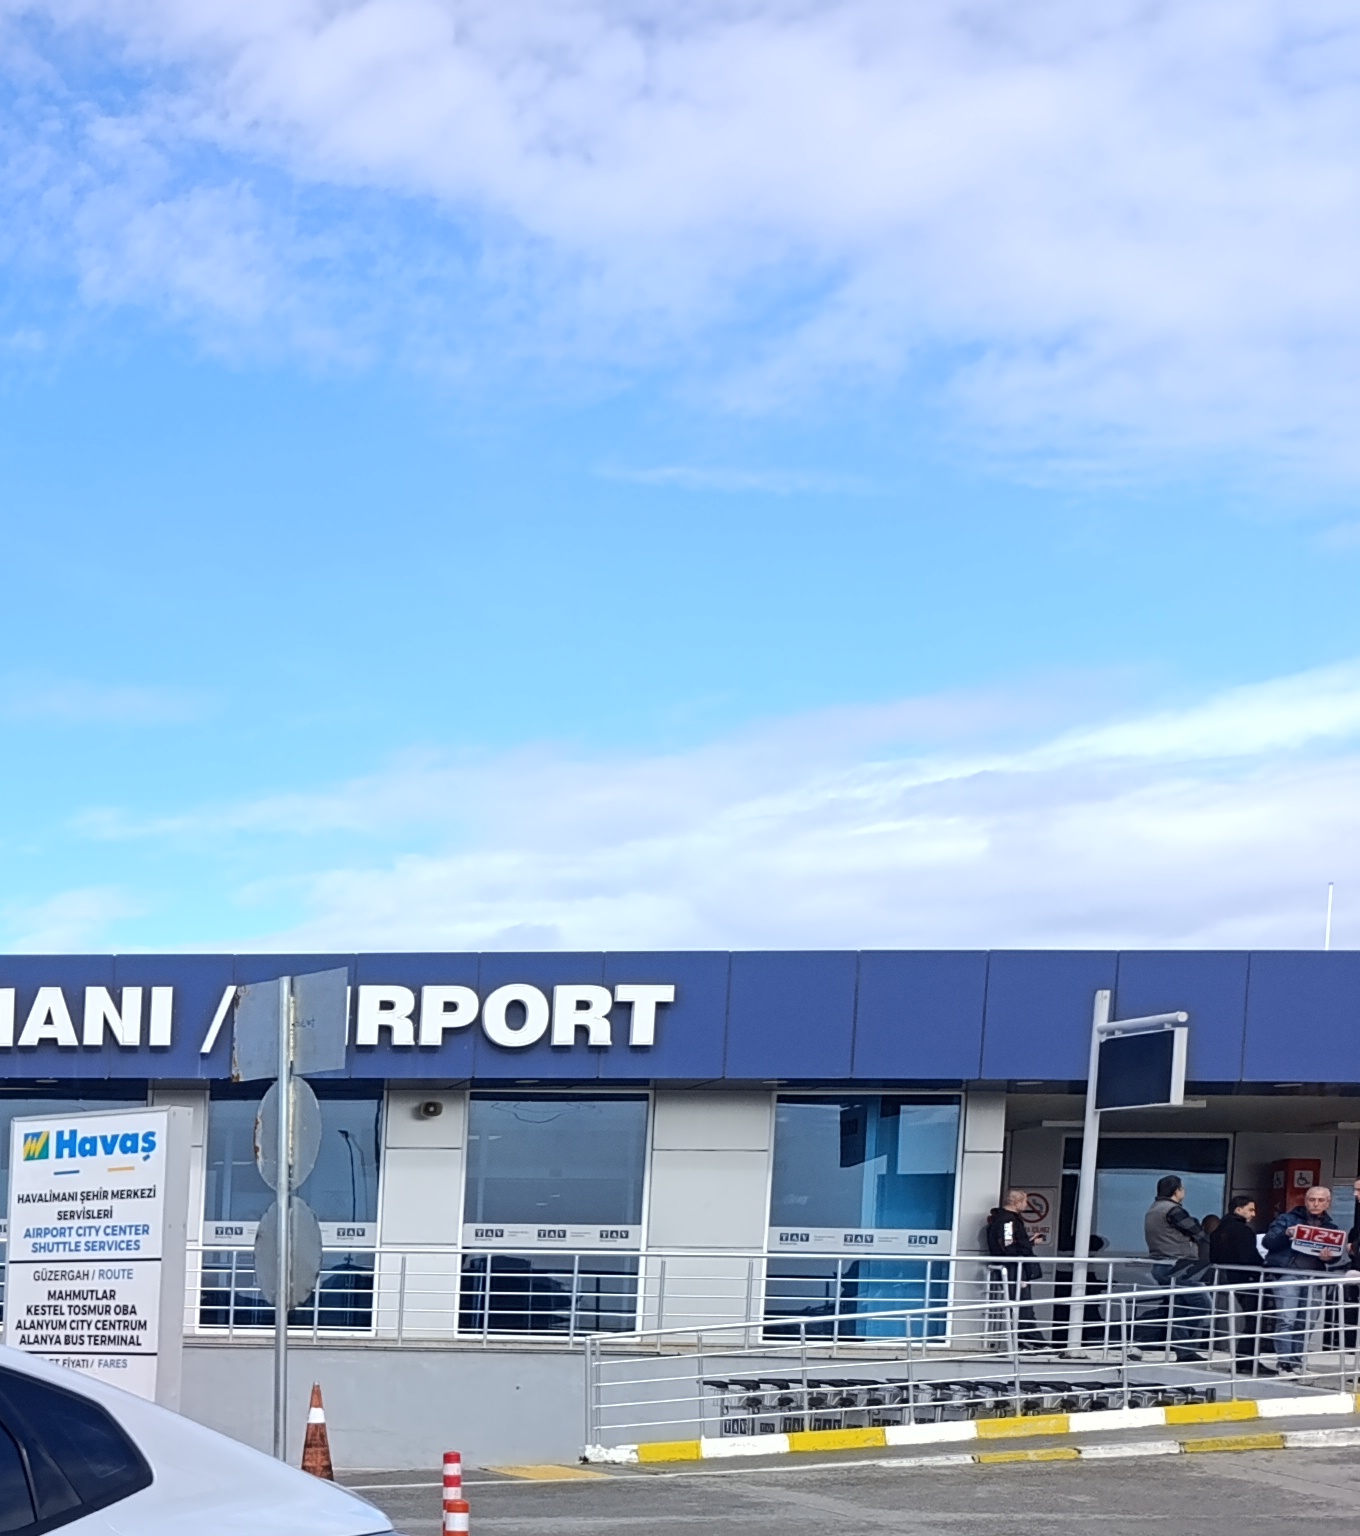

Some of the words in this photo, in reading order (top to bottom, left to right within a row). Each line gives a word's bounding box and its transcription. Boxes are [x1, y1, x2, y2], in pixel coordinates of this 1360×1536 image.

[55, 1129, 157, 1162] Havaş
[17, 1189, 78, 1204] HAVALİMANI
[80, 1187, 109, 1204] ŞEHİR
[111, 1185, 156, 1200] MERKEZİ
[57, 1205, 113, 1220] SERVİSLERİ
[23, 1225, 73, 1239] AIRPORT
[75, 1225, 101, 1237] CITY
[103, 1223, 150, 1236] CENTER
[31, 1241, 82, 1253] SHUTTLE
[84, 1239, 141, 1252] SERVICES
[33, 1268, 89, 1281] GÜZERGAH
[98, 1268, 134, 1280] ROUTE
[47, 1289, 116, 1301] MAHMUTLAR
[26, 1304, 65, 1316] KESTEL
[67, 1304, 111, 1316] TOSMUR
[114, 1304, 137, 1316] OBA
[15, 1319, 67, 1331] ALANYUM
[69, 1319, 92, 1331] CITY
[95, 1319, 147, 1331] CENTRUM
[19, 1334, 62, 1345] ALANYA
[64, 1334, 85, 1345] BUS
[87, 1334, 142, 1346] TERMINAL
[98, 1359, 128, 1368] FARES
